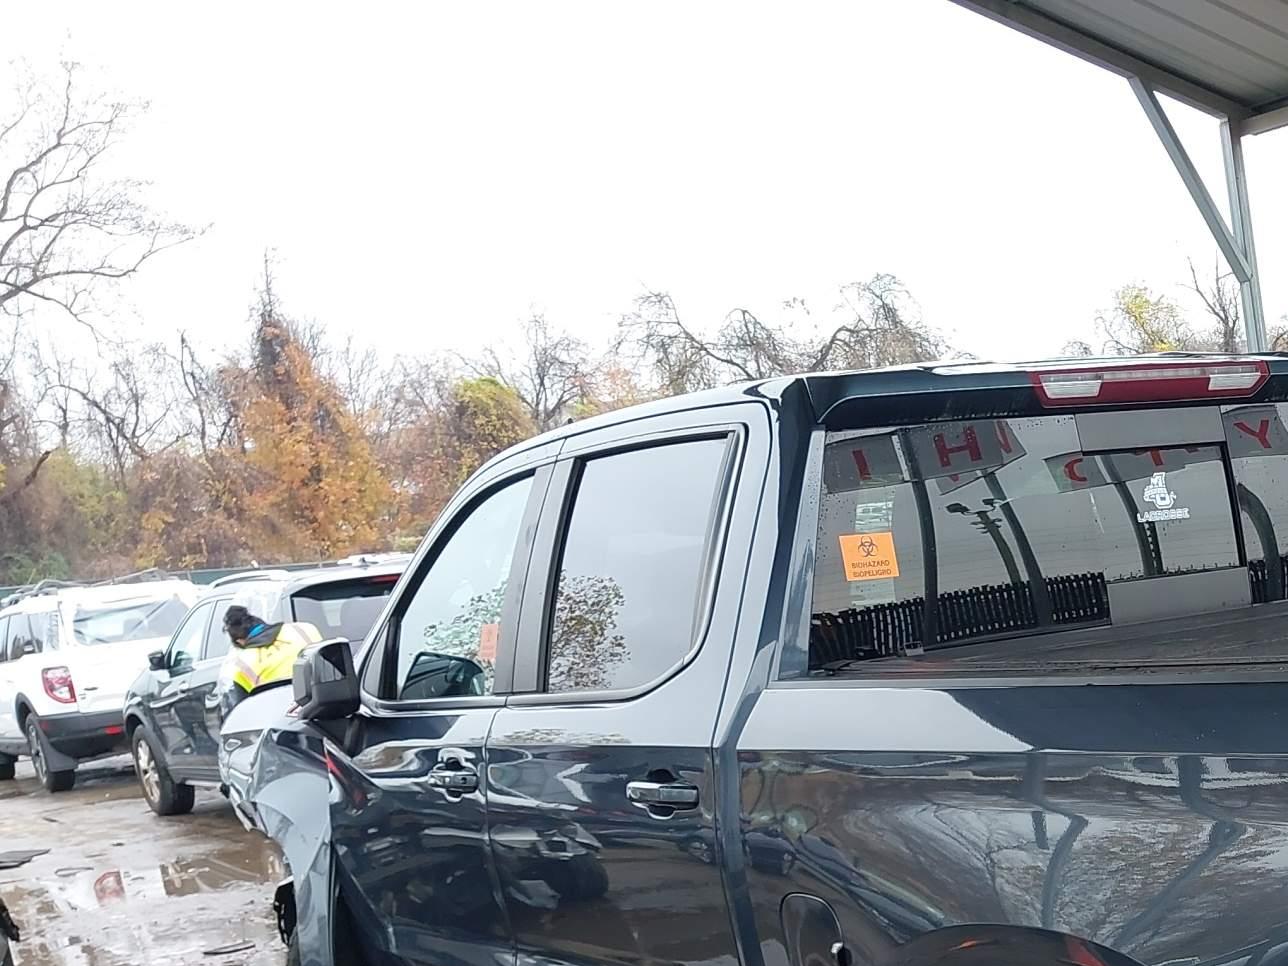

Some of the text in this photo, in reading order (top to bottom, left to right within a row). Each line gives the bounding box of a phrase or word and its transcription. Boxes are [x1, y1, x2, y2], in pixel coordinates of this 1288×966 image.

[1136, 507, 1191, 523] LACROSSE
[851, 559, 891, 569] BIOHAZARD
[853, 568, 893, 578] BIOPELIGRO
